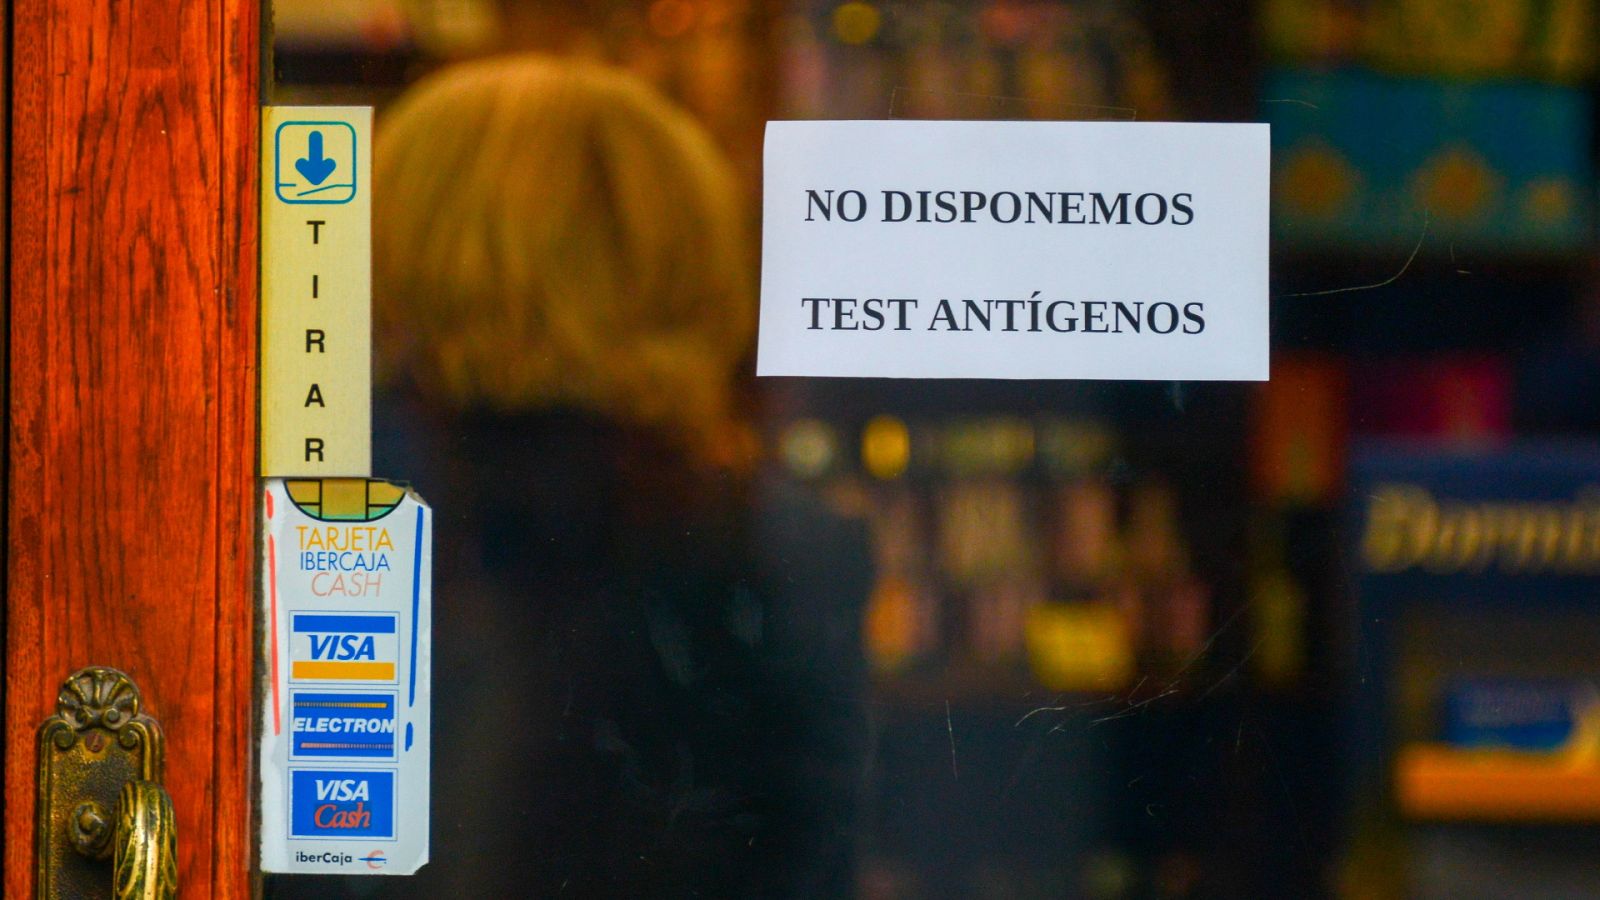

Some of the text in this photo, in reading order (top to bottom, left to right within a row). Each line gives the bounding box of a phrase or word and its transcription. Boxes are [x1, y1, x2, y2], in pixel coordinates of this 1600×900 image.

[804, 189, 1195, 226] NO DISPONEMOS
[801, 291, 1206, 335] TEST ANTÍGENOS
[304, 220, 326, 462] TIRAR
[296, 525, 394, 551] TARJETA
[300, 551, 391, 571] IBERCAJA
[311, 571, 383, 597] CASH
[307, 634, 375, 661] VISA
[293, 717, 396, 734] ELECTRON
[315, 779, 369, 801] VISA
[314, 801, 372, 828] Cash
[295, 851, 353, 866] iberCaja
